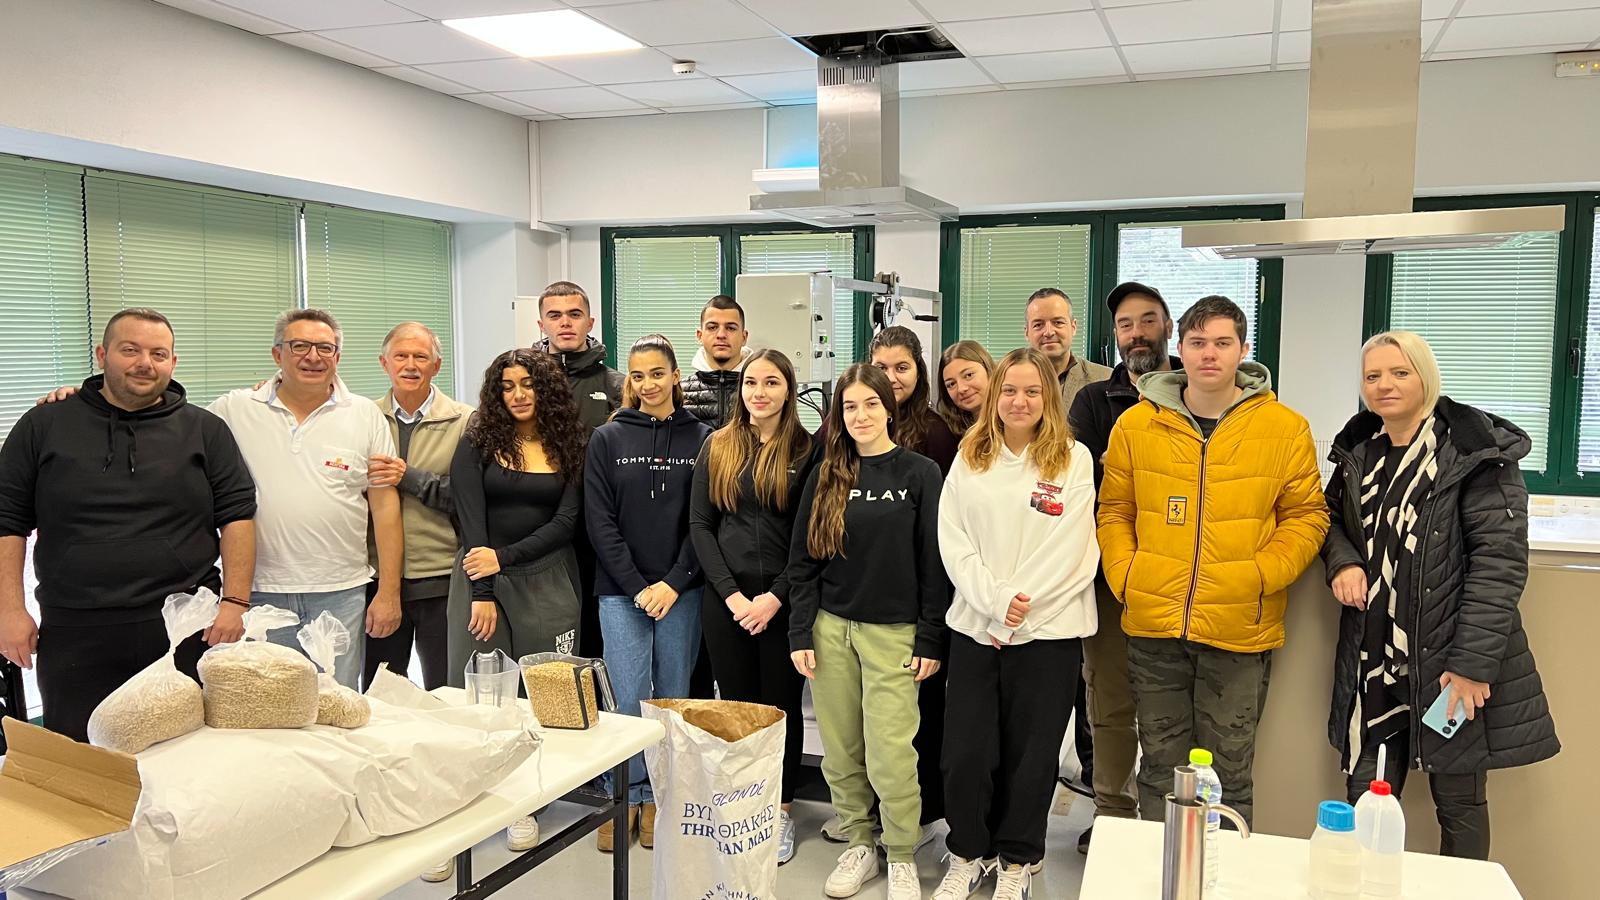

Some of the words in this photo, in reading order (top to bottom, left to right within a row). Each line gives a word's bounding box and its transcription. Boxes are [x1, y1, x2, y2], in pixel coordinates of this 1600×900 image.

[616, 456, 652, 466] TOMMY
[848, 488, 908, 502] PLAY
[555, 629, 576, 647] NIKE
[718, 804, 774, 838] ΘΡΑΚΗΣ
[681, 823, 744, 855] THRIAN
[747, 824, 773, 851] MALT
